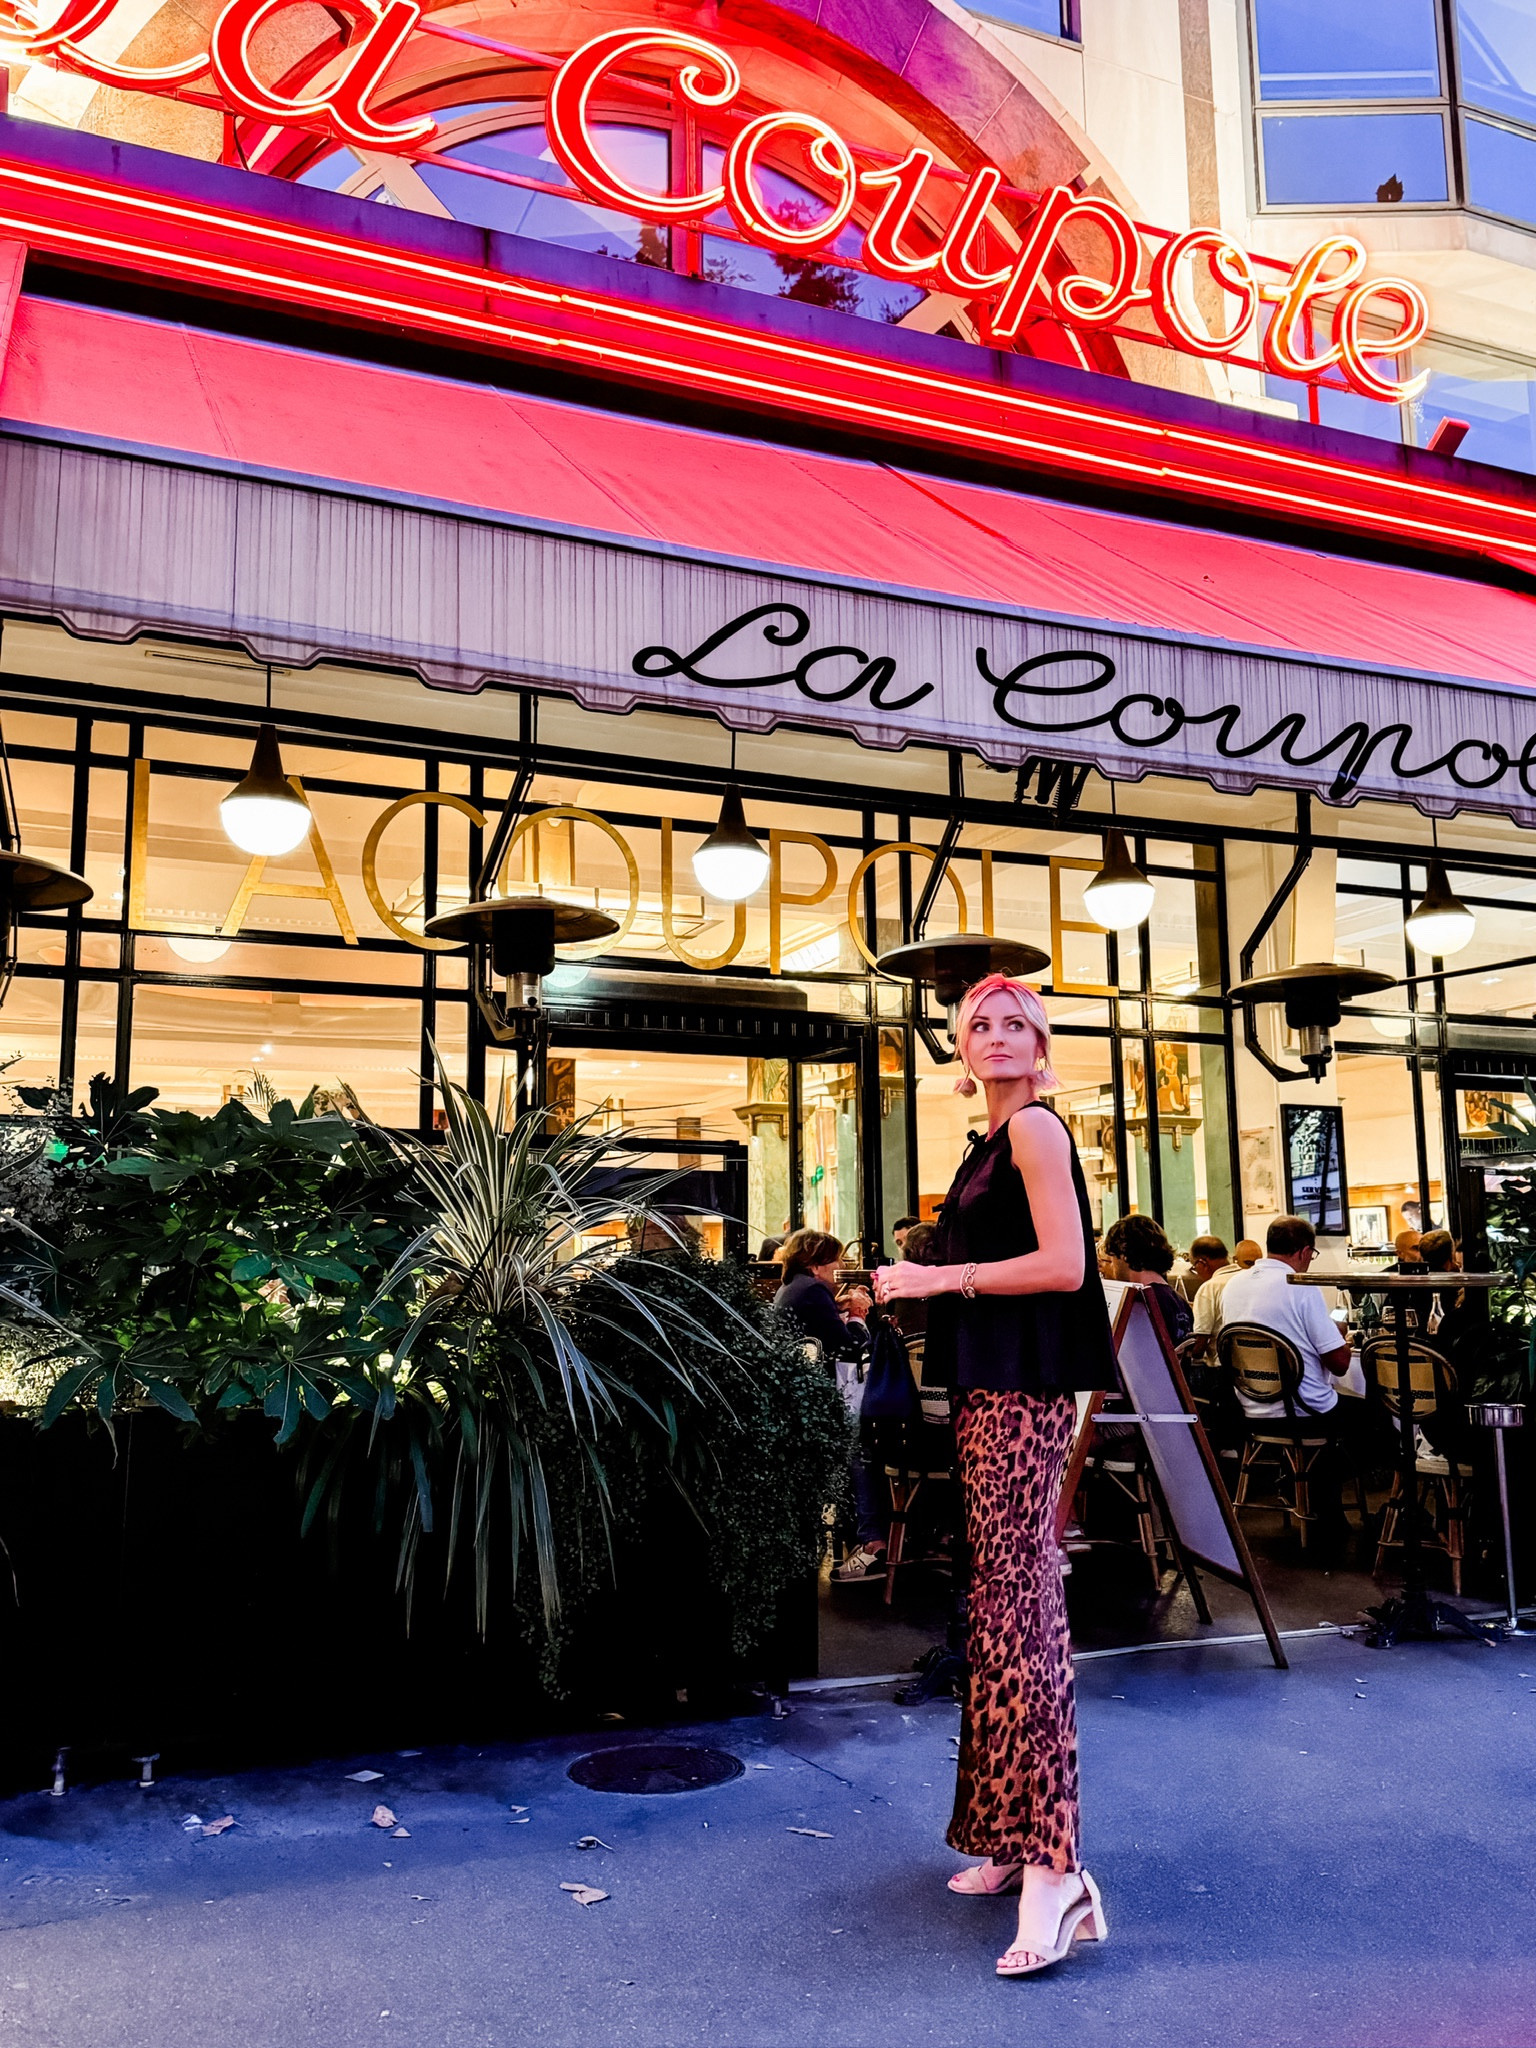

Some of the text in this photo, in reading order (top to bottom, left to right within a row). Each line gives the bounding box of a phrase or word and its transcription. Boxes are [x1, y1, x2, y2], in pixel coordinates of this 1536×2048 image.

[546, 27, 1431, 405] Coupole
[632, 602, 1536, 799] La Coupo
